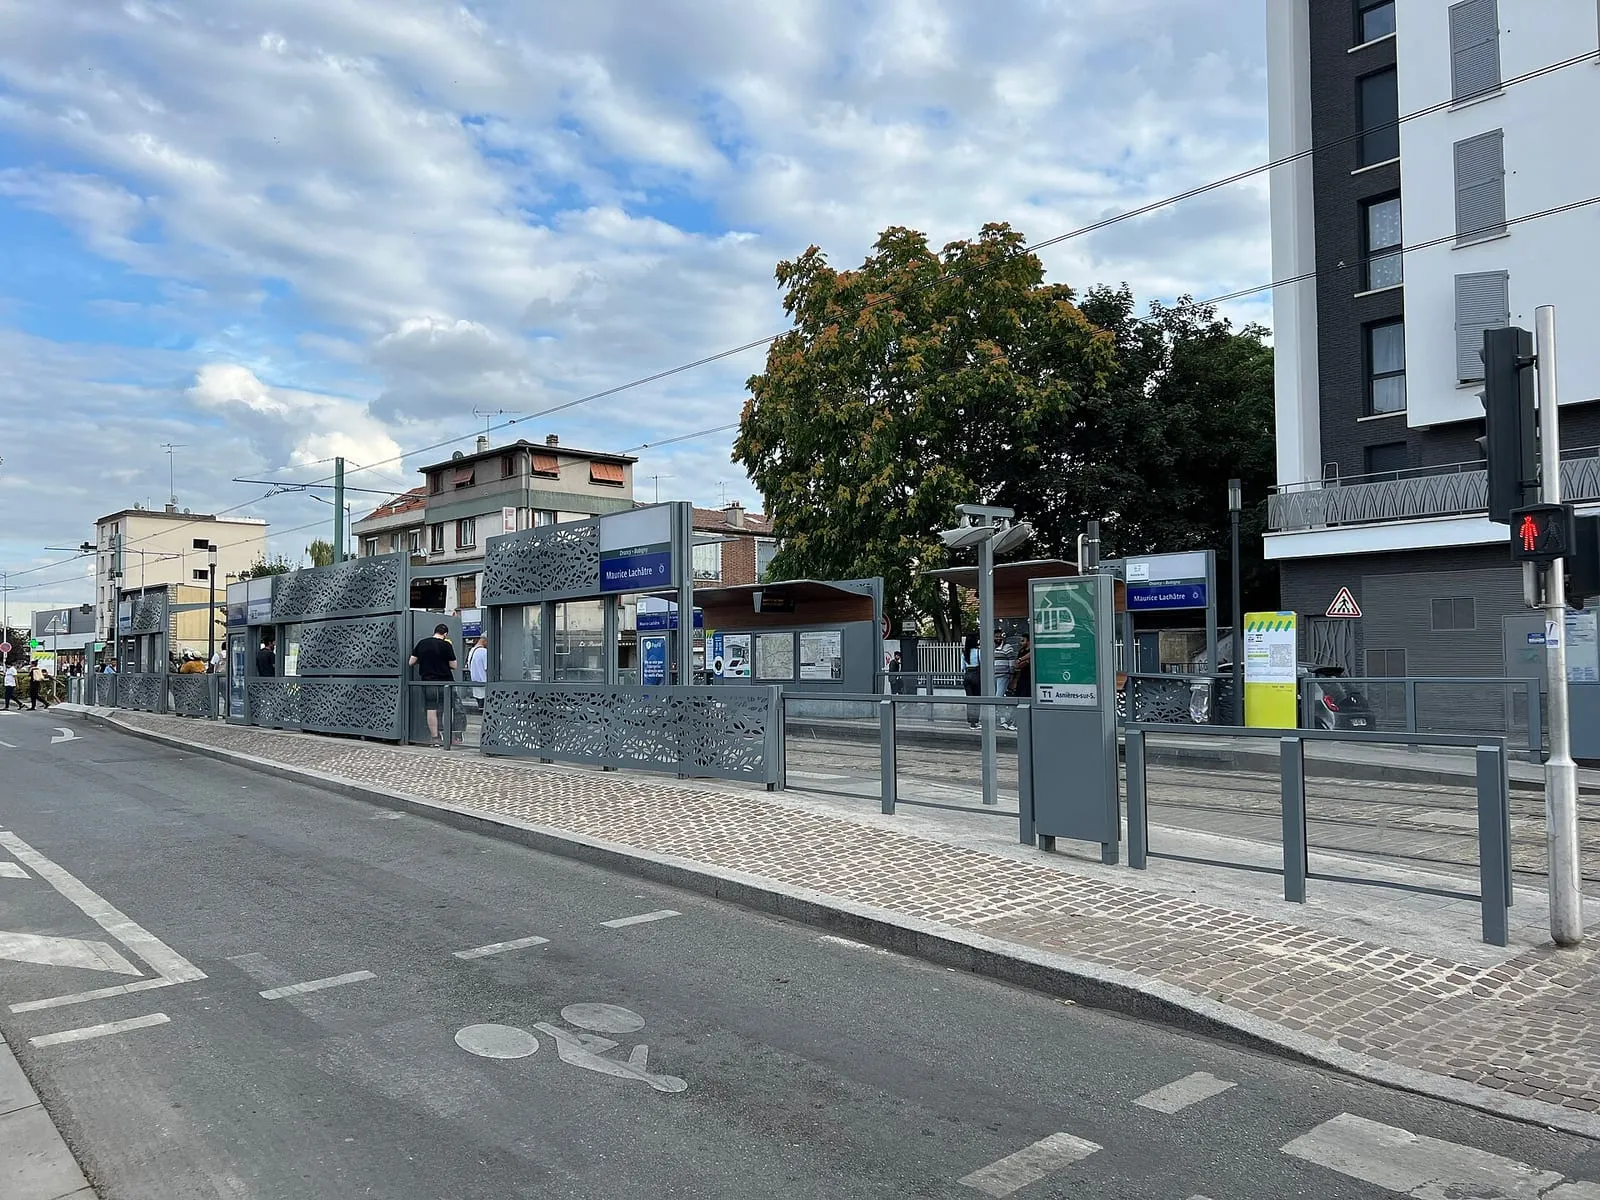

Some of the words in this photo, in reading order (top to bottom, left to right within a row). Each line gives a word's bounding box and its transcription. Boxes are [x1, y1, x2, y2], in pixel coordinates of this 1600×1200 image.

[606, 569, 628, 580] Maurice
[628, 566, 653, 577] Lachâtre
[1159, 593, 1186, 601] Lachâtre
[1042, 690, 1052, 698] T1
[1055, 691, 1096, 700] Asnières-sur-S.
